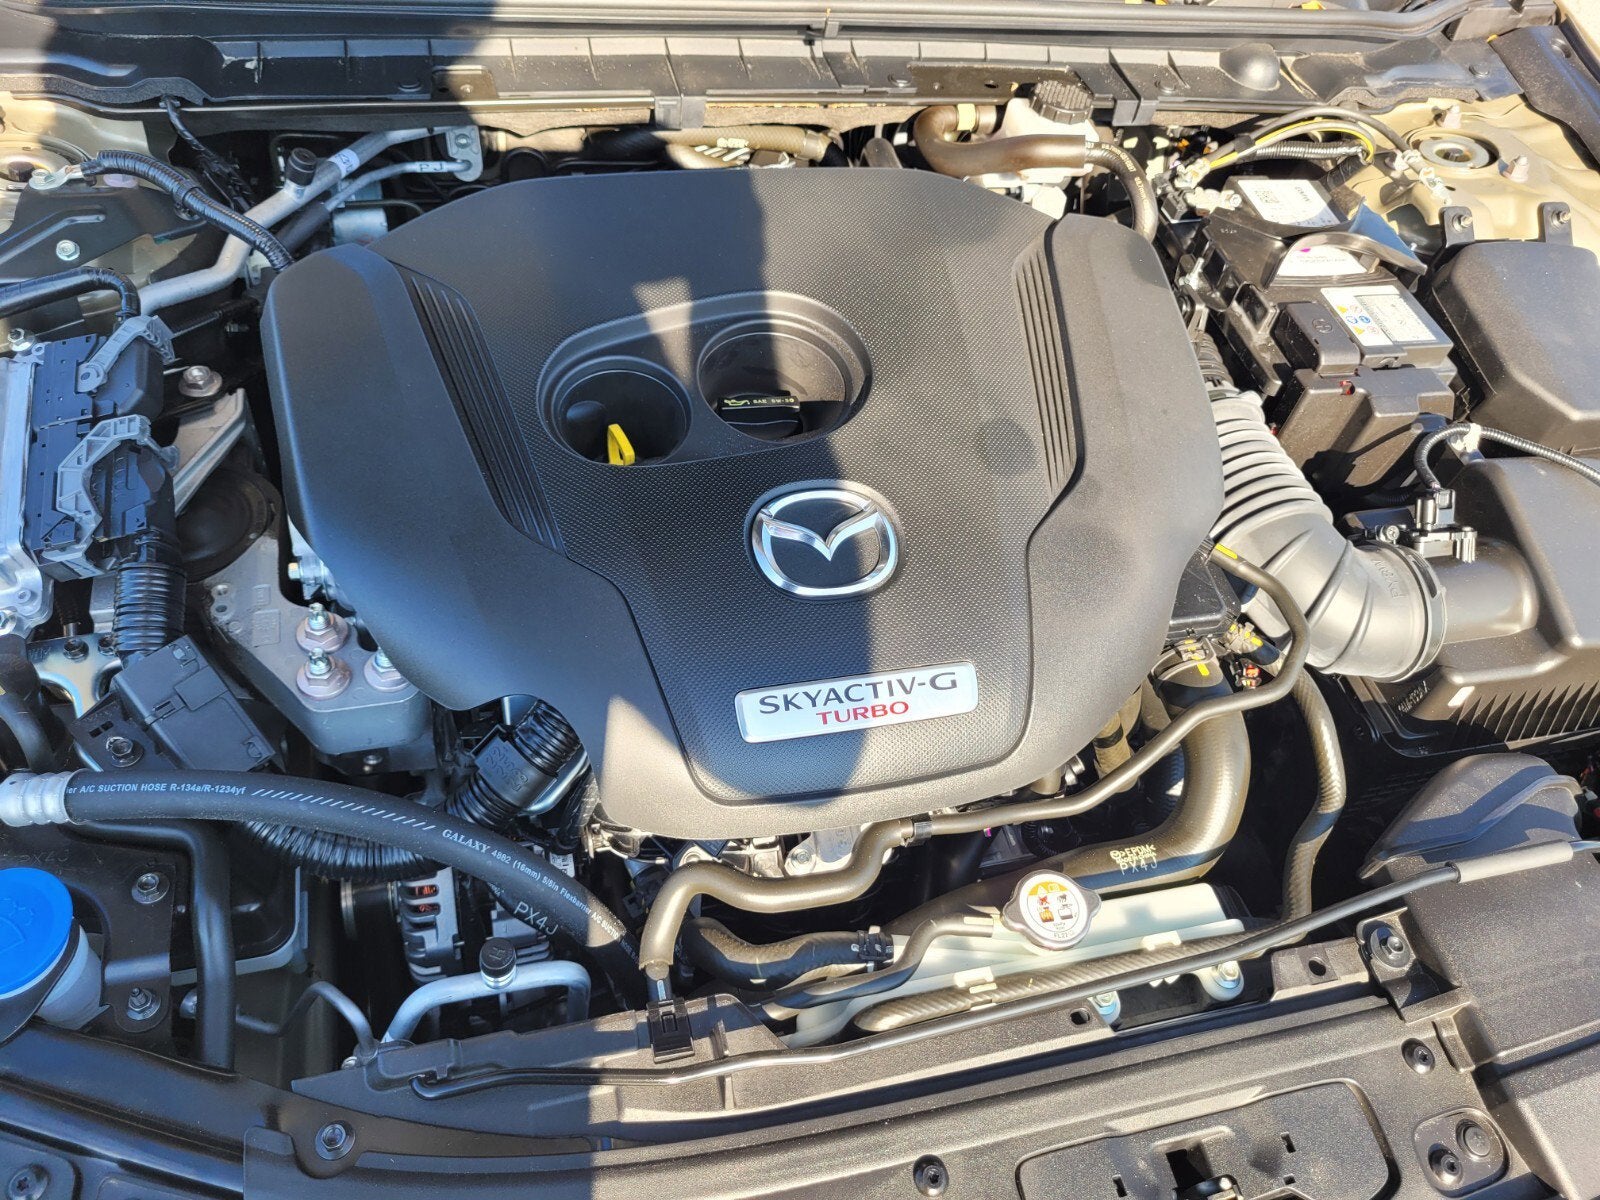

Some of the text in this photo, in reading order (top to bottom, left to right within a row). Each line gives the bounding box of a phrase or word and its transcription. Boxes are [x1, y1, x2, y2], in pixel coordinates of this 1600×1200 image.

[759, 672, 958, 714] SKYACTIV-G
[816, 701, 909, 725] TURBO
[80, 785, 95, 793] A/C
[97, 784, 138, 792] SUCTION
[140, 783, 168, 792] HOSE
[170, 783, 247, 796] R-134a/R-1234yf
[442, 829, 491, 854] GALAXY
[1120, 857, 1158, 875] PX4J
[513, 901, 559, 936] PX4J
